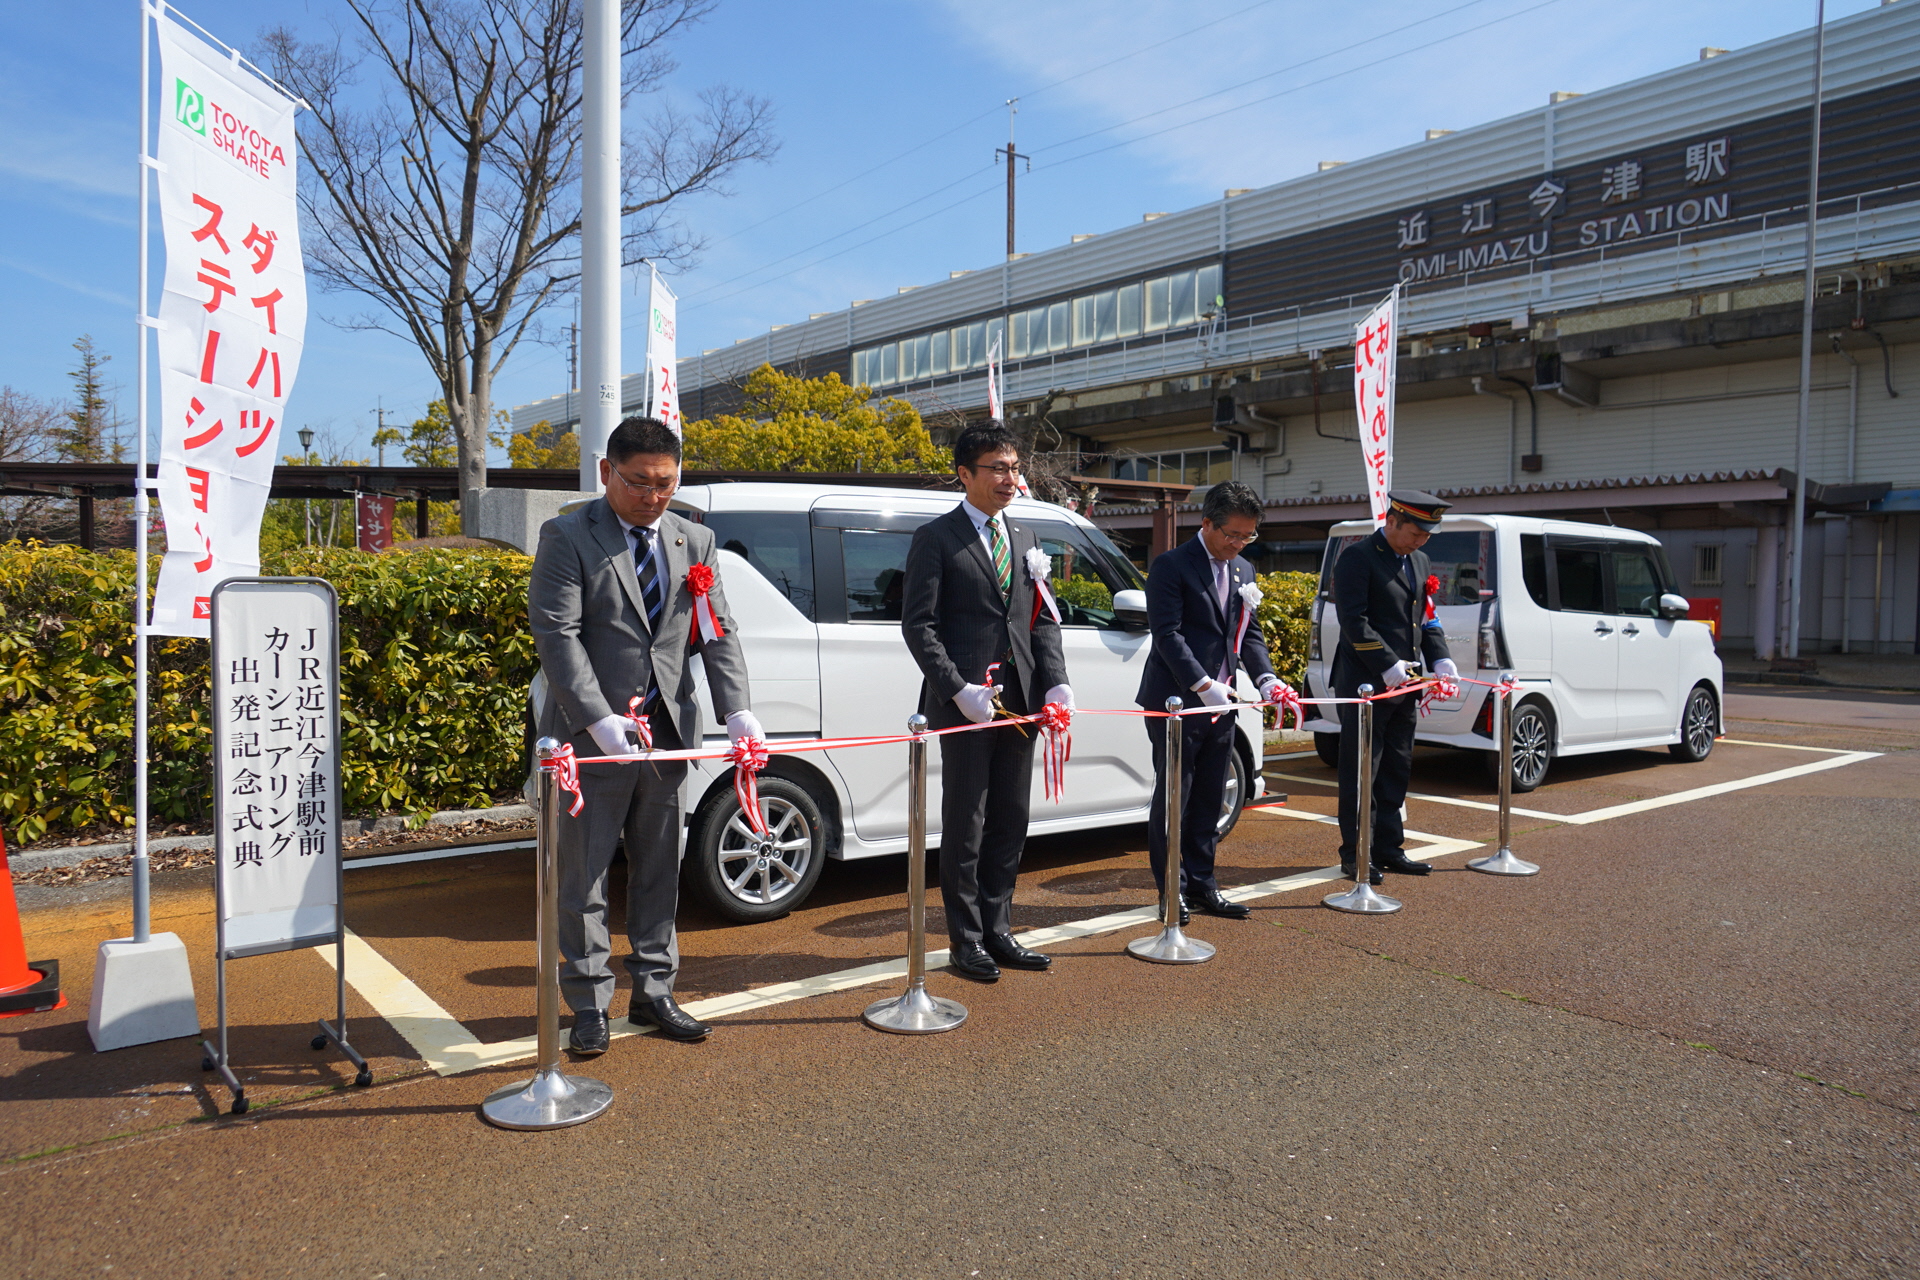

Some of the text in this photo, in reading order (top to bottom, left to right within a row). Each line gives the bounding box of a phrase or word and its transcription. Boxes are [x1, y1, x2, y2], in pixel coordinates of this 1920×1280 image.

[210, 101, 286, 167] TOYOTA
[212, 127, 270, 180] SHARE
[1398, 138, 1727, 249] 近江今津駅
[1580, 193, 1728, 246] STATION
[183, 192, 237, 574] ステーション
[235, 222, 284, 458] ダイハツ
[600, 391, 615, 400] 745
[230, 657, 264, 870] 出発記念式典
[264, 627, 296, 860] カーシェアリング
[295, 628, 327, 857] JR近江今津駅前
